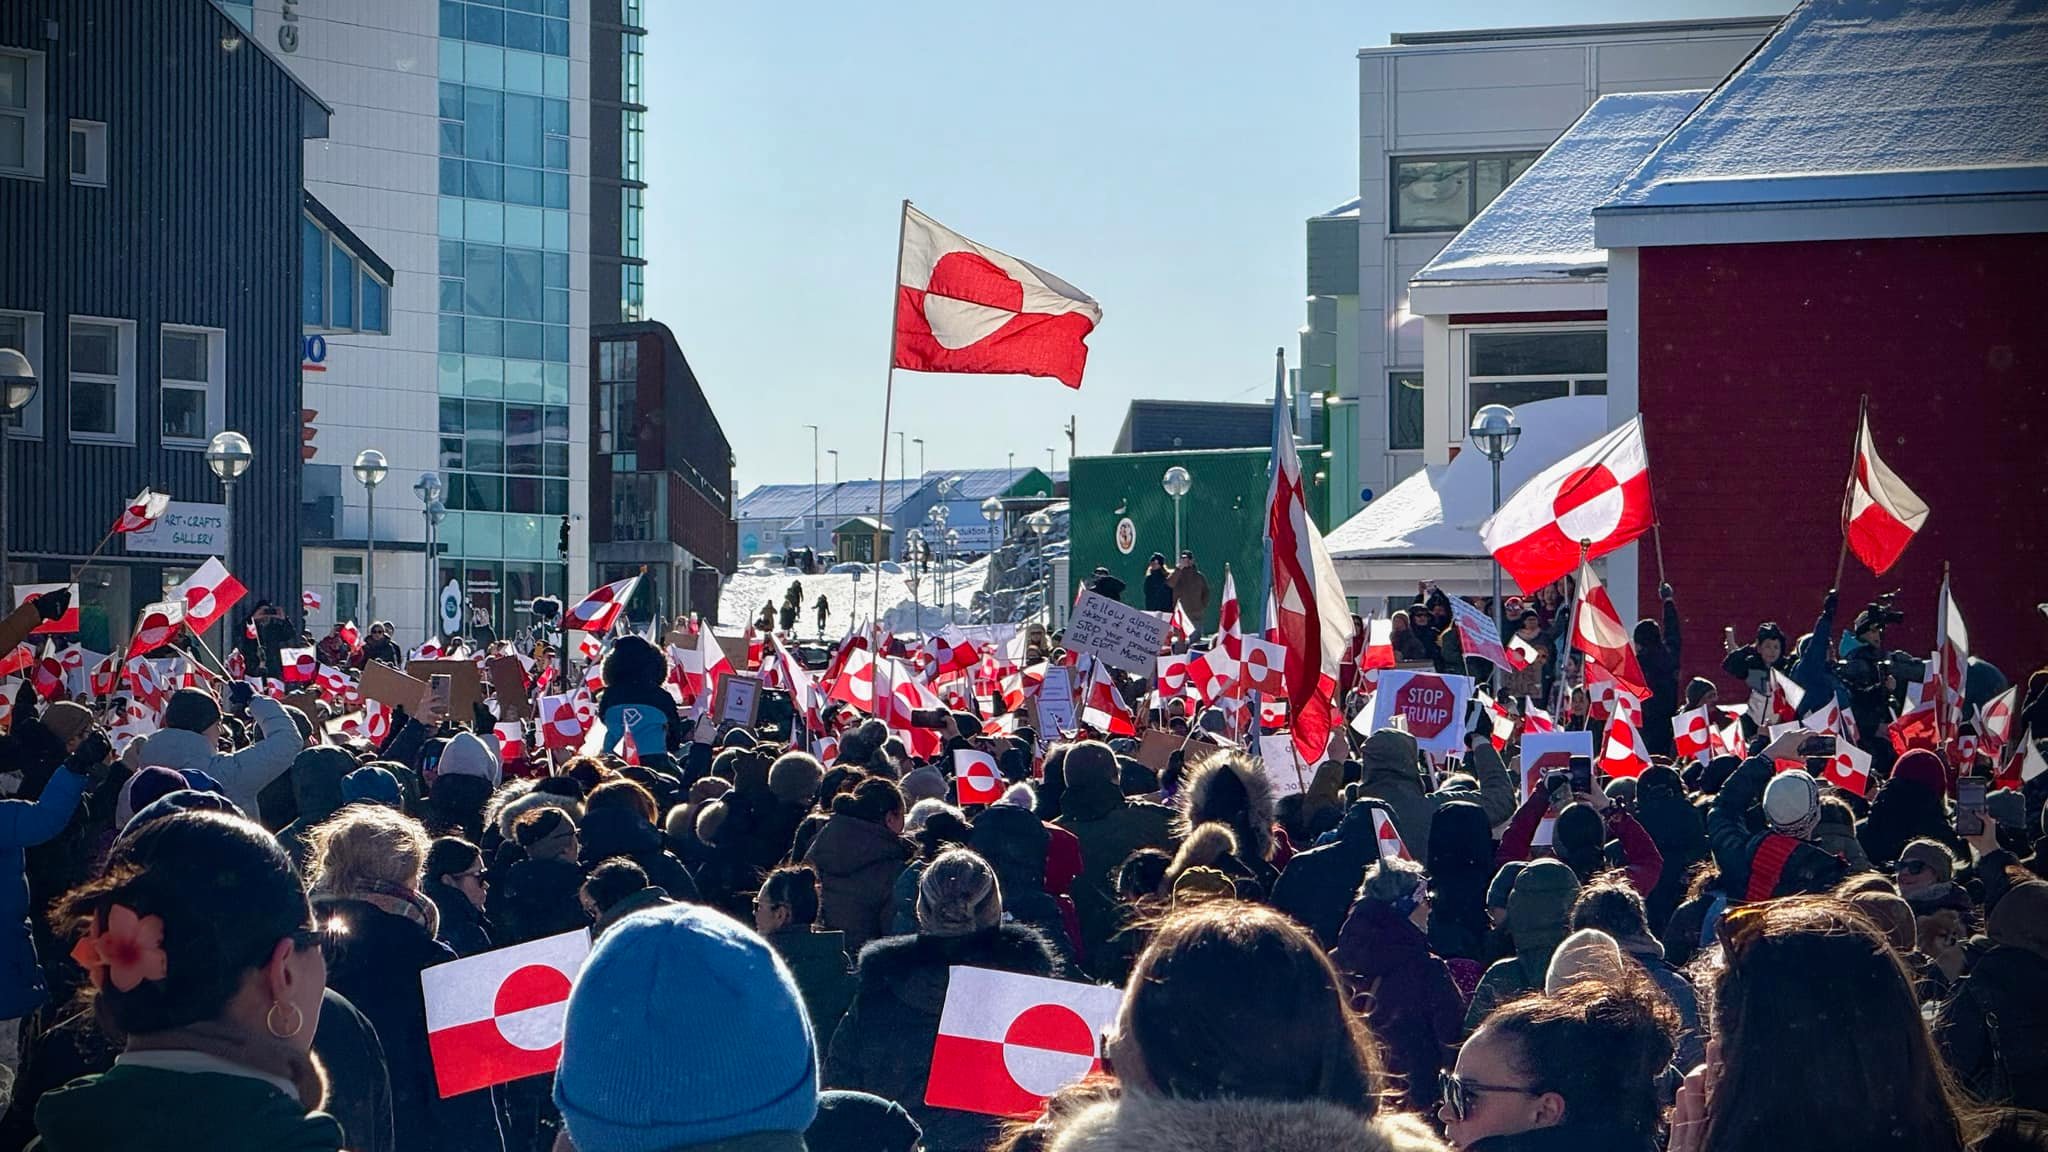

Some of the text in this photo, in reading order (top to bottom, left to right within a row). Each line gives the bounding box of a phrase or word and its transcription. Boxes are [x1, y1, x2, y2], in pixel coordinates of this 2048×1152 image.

[278, 0, 299, 53] Gr
[172, 532, 214, 545] GALLERY
[1086, 597, 1125, 620] Fellow
[1129, 616, 1160, 635] alpine
[1126, 626, 1141, 638] the
[1091, 639, 1115, 651] Elon
[1407, 687, 1444, 705] STOP
[1400, 705, 1448, 724] TRUMP
